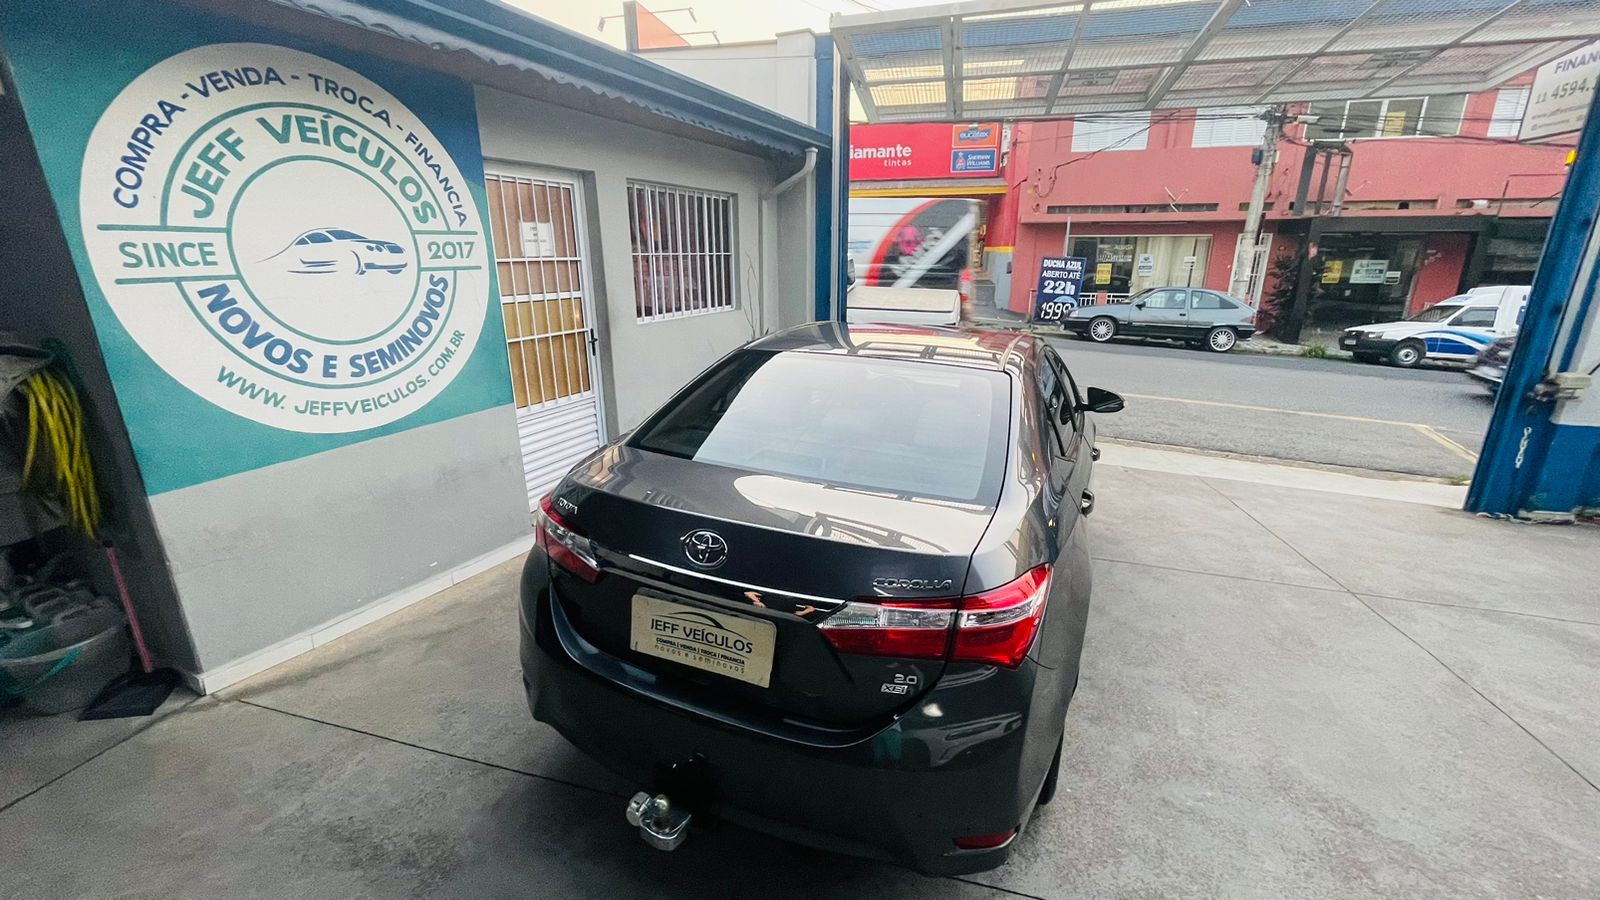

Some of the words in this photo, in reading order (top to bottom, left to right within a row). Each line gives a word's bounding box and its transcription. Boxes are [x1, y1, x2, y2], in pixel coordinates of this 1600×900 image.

[113, 100, 187, 208] COMPRA
[185, 67, 286, 97] VENDA
[307, 73, 391, 128] TROCA
[405, 132, 467, 227] FINANCIA
[850, 144, 912, 159] iamante
[181, 127, 246, 218] JEFF
[256, 113, 437, 224] VEÍCULOS
[884, 158, 912, 167] tintas
[118, 242, 218, 268] SINCE
[427, 241, 475, 260] 2017
[1043, 259, 1065, 269] DUCHA
[1065, 260, 1082, 270] AZUL
[1041, 270, 1068, 279] ABERTO
[1068, 271, 1081, 280] ATÉ
[1042, 280, 1076, 295] 22h
[197, 283, 313, 374] NOVOS
[322, 355, 338, 378] E
[350, 273, 449, 377] SEMINOVOS
[872, 577, 952, 590] COROLLA
[650, 618, 680, 634] JEFF
[683, 626, 753, 654] VEÍCULOS
[654, 644, 682, 656] novos
[656, 637, 677, 647] COMPRA
[680, 644, 697, 653] VENDA
[700, 649, 717, 659] TROCA
[720, 654, 745, 666] FINANCIA
[894, 674, 917, 684] 2.0
